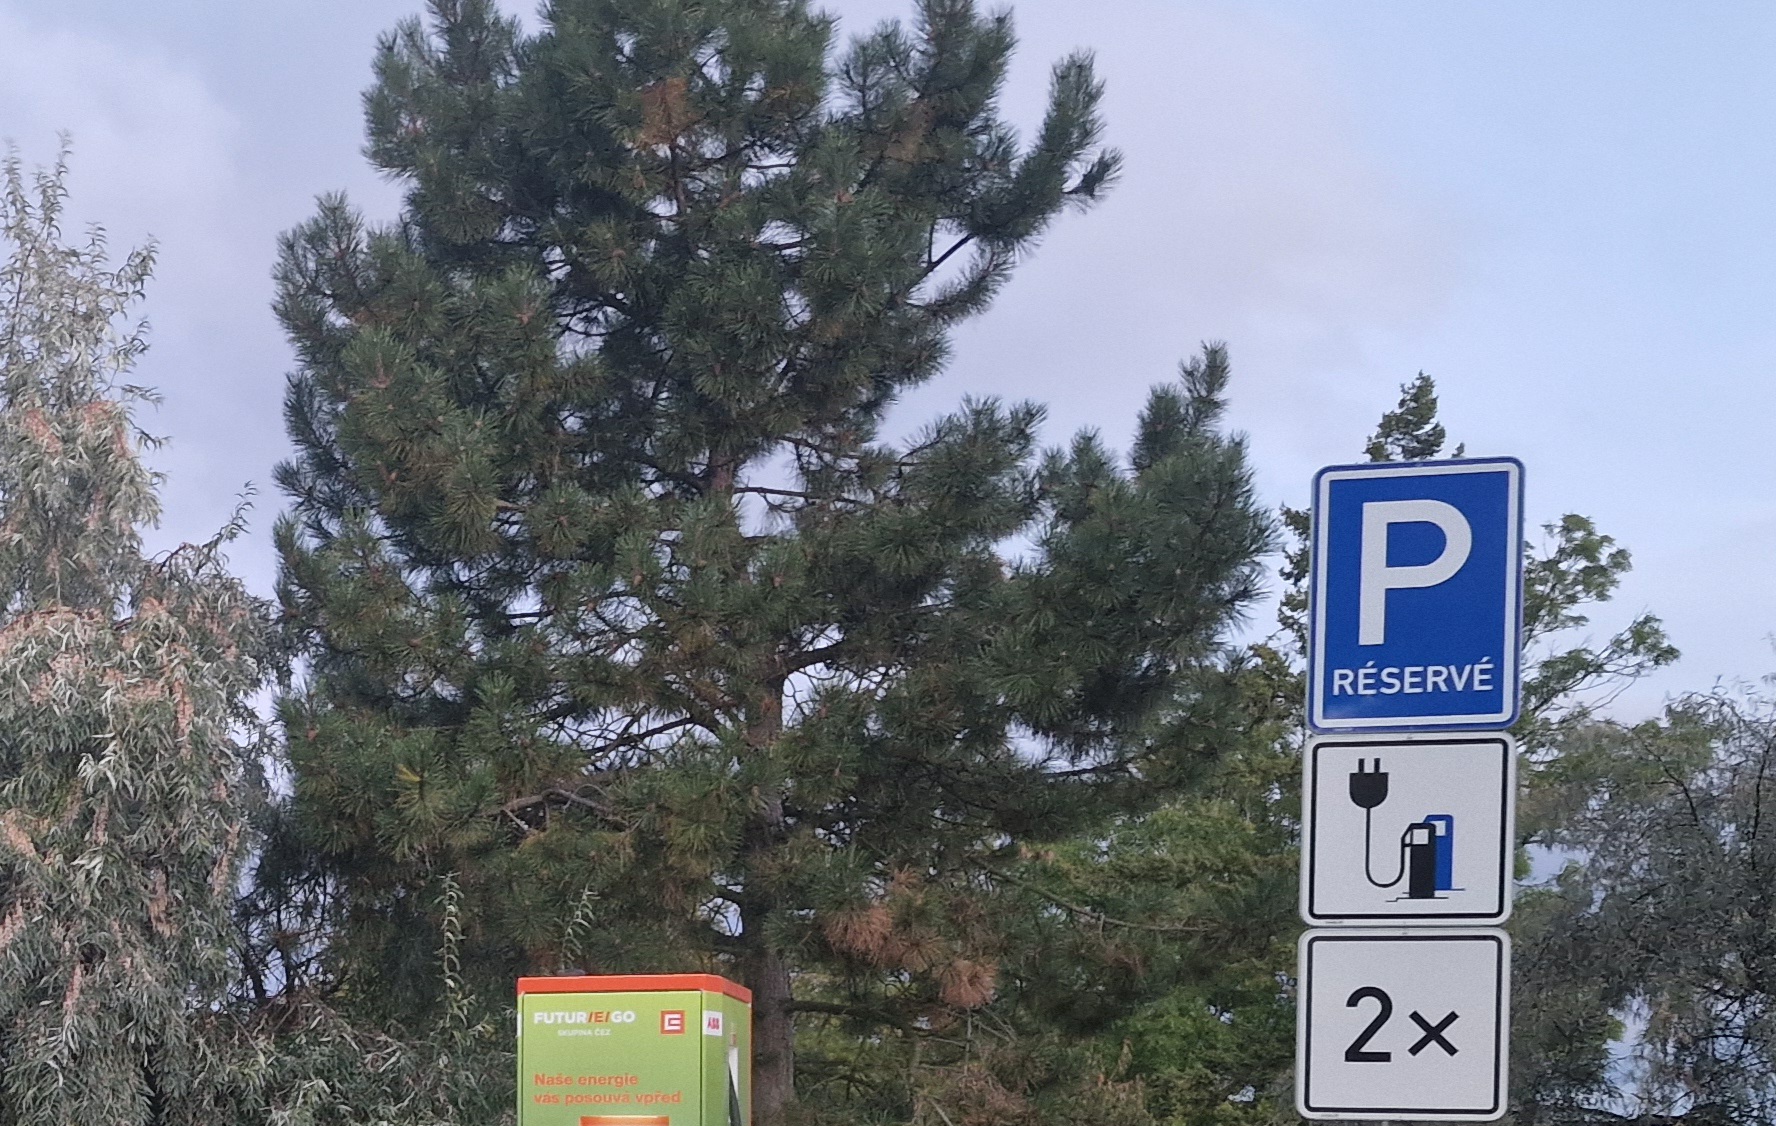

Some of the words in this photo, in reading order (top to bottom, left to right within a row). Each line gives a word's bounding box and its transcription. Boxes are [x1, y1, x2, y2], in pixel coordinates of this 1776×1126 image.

[1358, 499, 1472, 646] P
[1333, 656, 1494, 696] RÉSERVÉ
[534, 1073, 573, 1086] Naše
[578, 1073, 639, 1088] energie
[635, 1091, 682, 1105] vpřed
